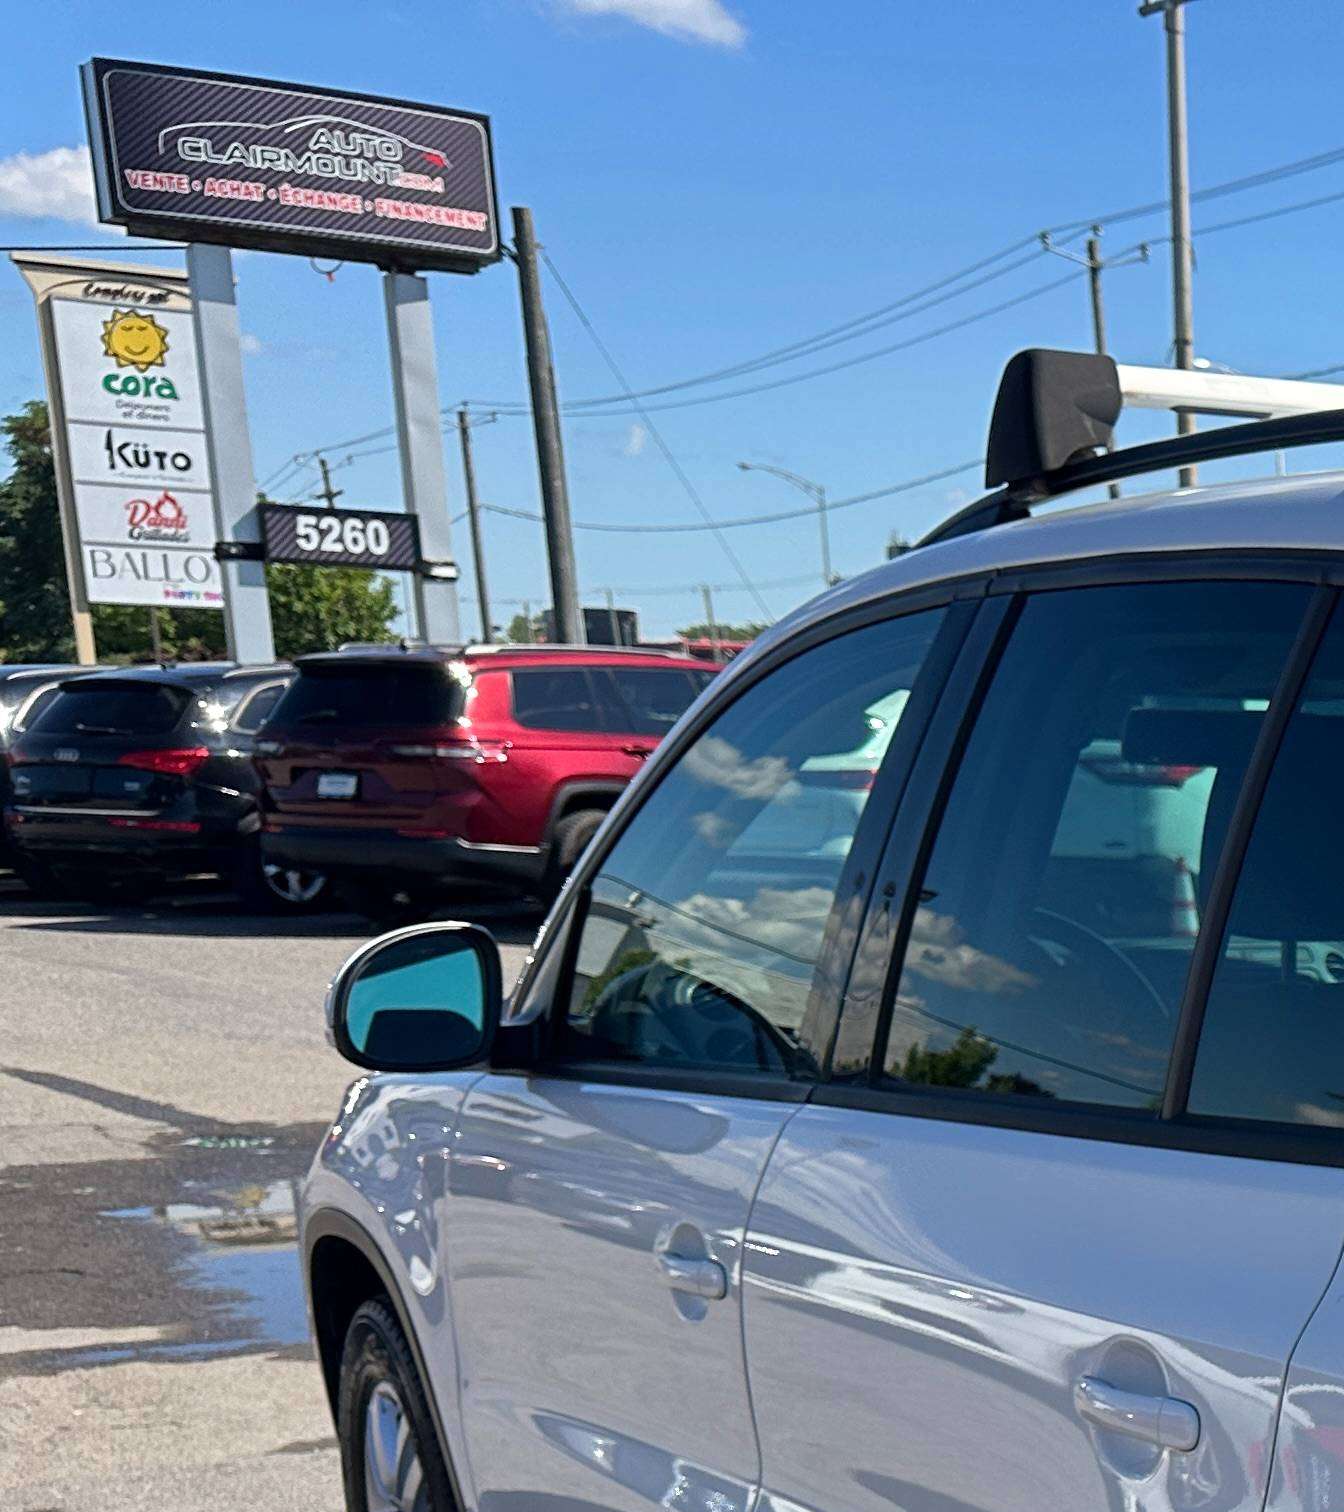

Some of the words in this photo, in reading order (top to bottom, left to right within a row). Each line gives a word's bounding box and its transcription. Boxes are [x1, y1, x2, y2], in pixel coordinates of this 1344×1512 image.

[177, 136, 404, 186] CLAIRMOUNT
[308, 127, 402, 161] AUTO
[124, 168, 191, 194] VENTE
[204, 177, 266, 202] ACHAT
[374, 197, 488, 232] FINANCEMENT
[102, 373, 178, 401] cora
[105, 429, 192, 472] KÜTO
[296, 514, 390, 556] 5260
[89, 549, 216, 584] BALLO
